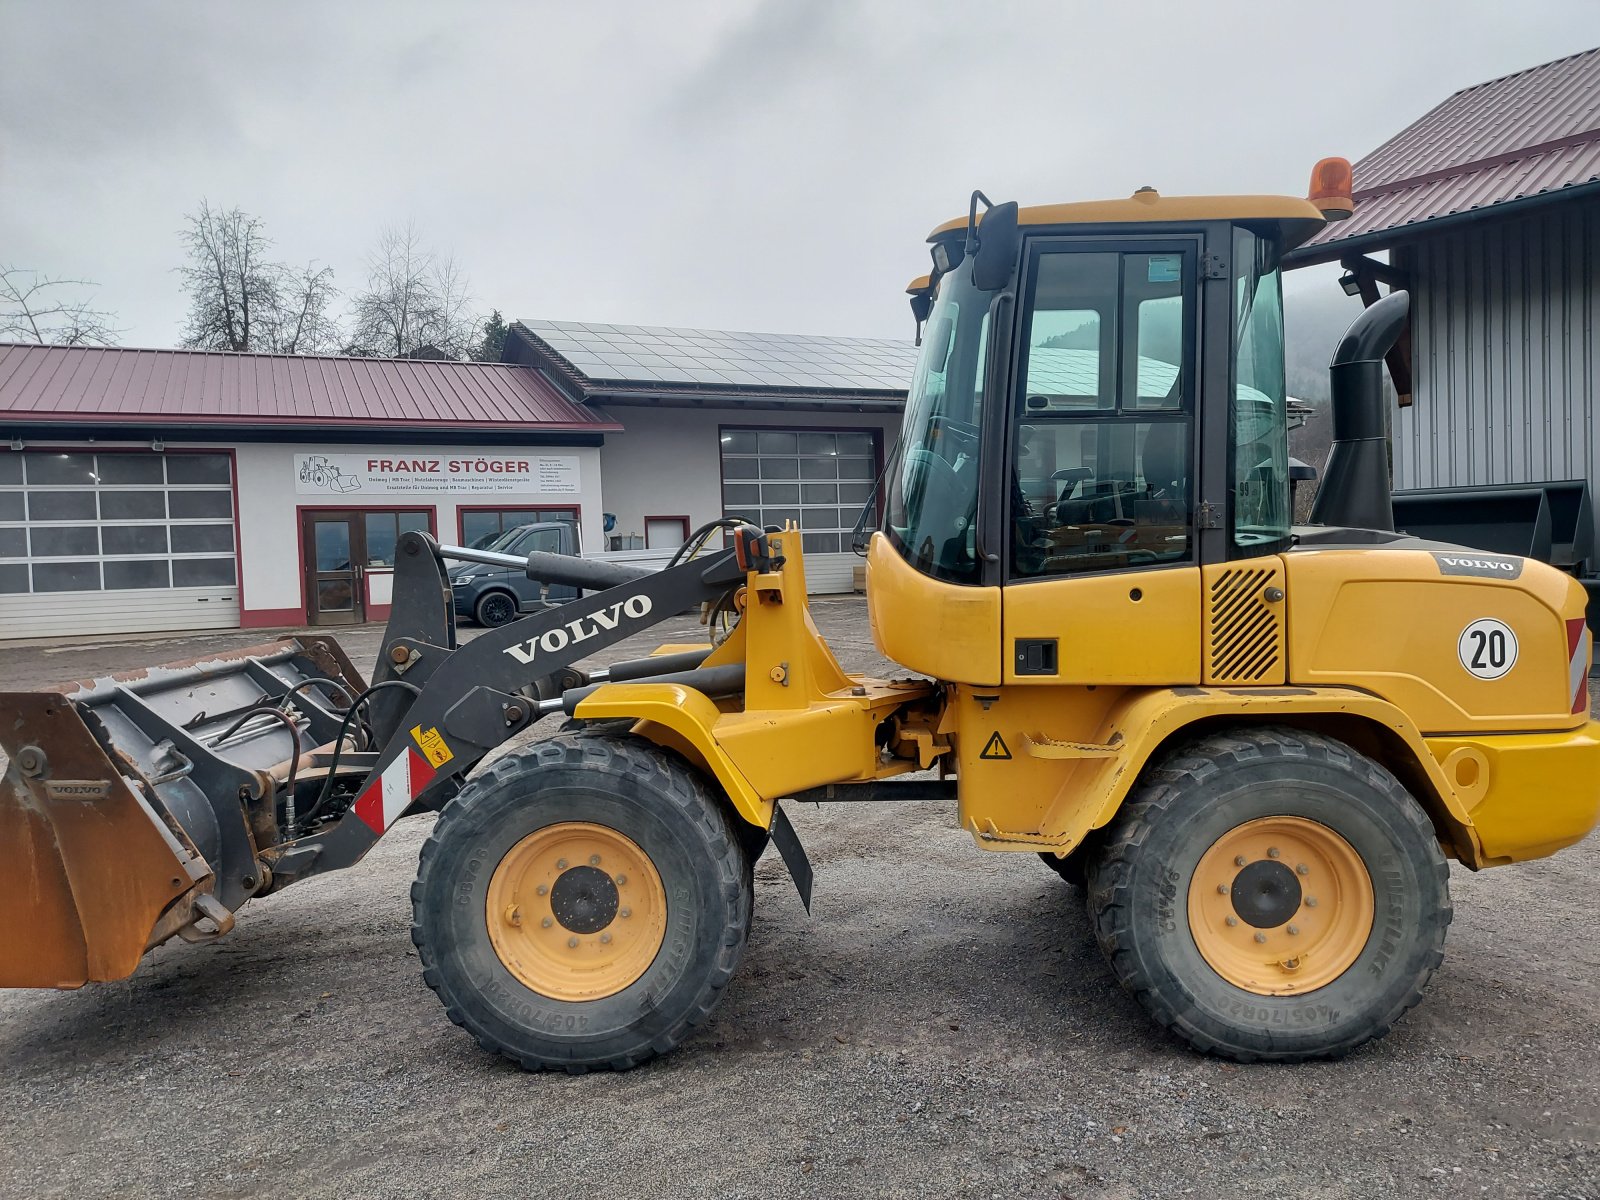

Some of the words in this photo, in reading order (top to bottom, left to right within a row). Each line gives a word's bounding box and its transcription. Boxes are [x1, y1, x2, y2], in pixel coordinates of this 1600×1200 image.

[367, 459, 441, 473] FRANZ
[448, 457, 530, 473] STÖGER
[1441, 557, 1514, 571] VOLVO
[503, 594, 653, 665] VOLVO
[1469, 629, 1506, 669] 20
[52, 786, 102, 794] VOLVO
